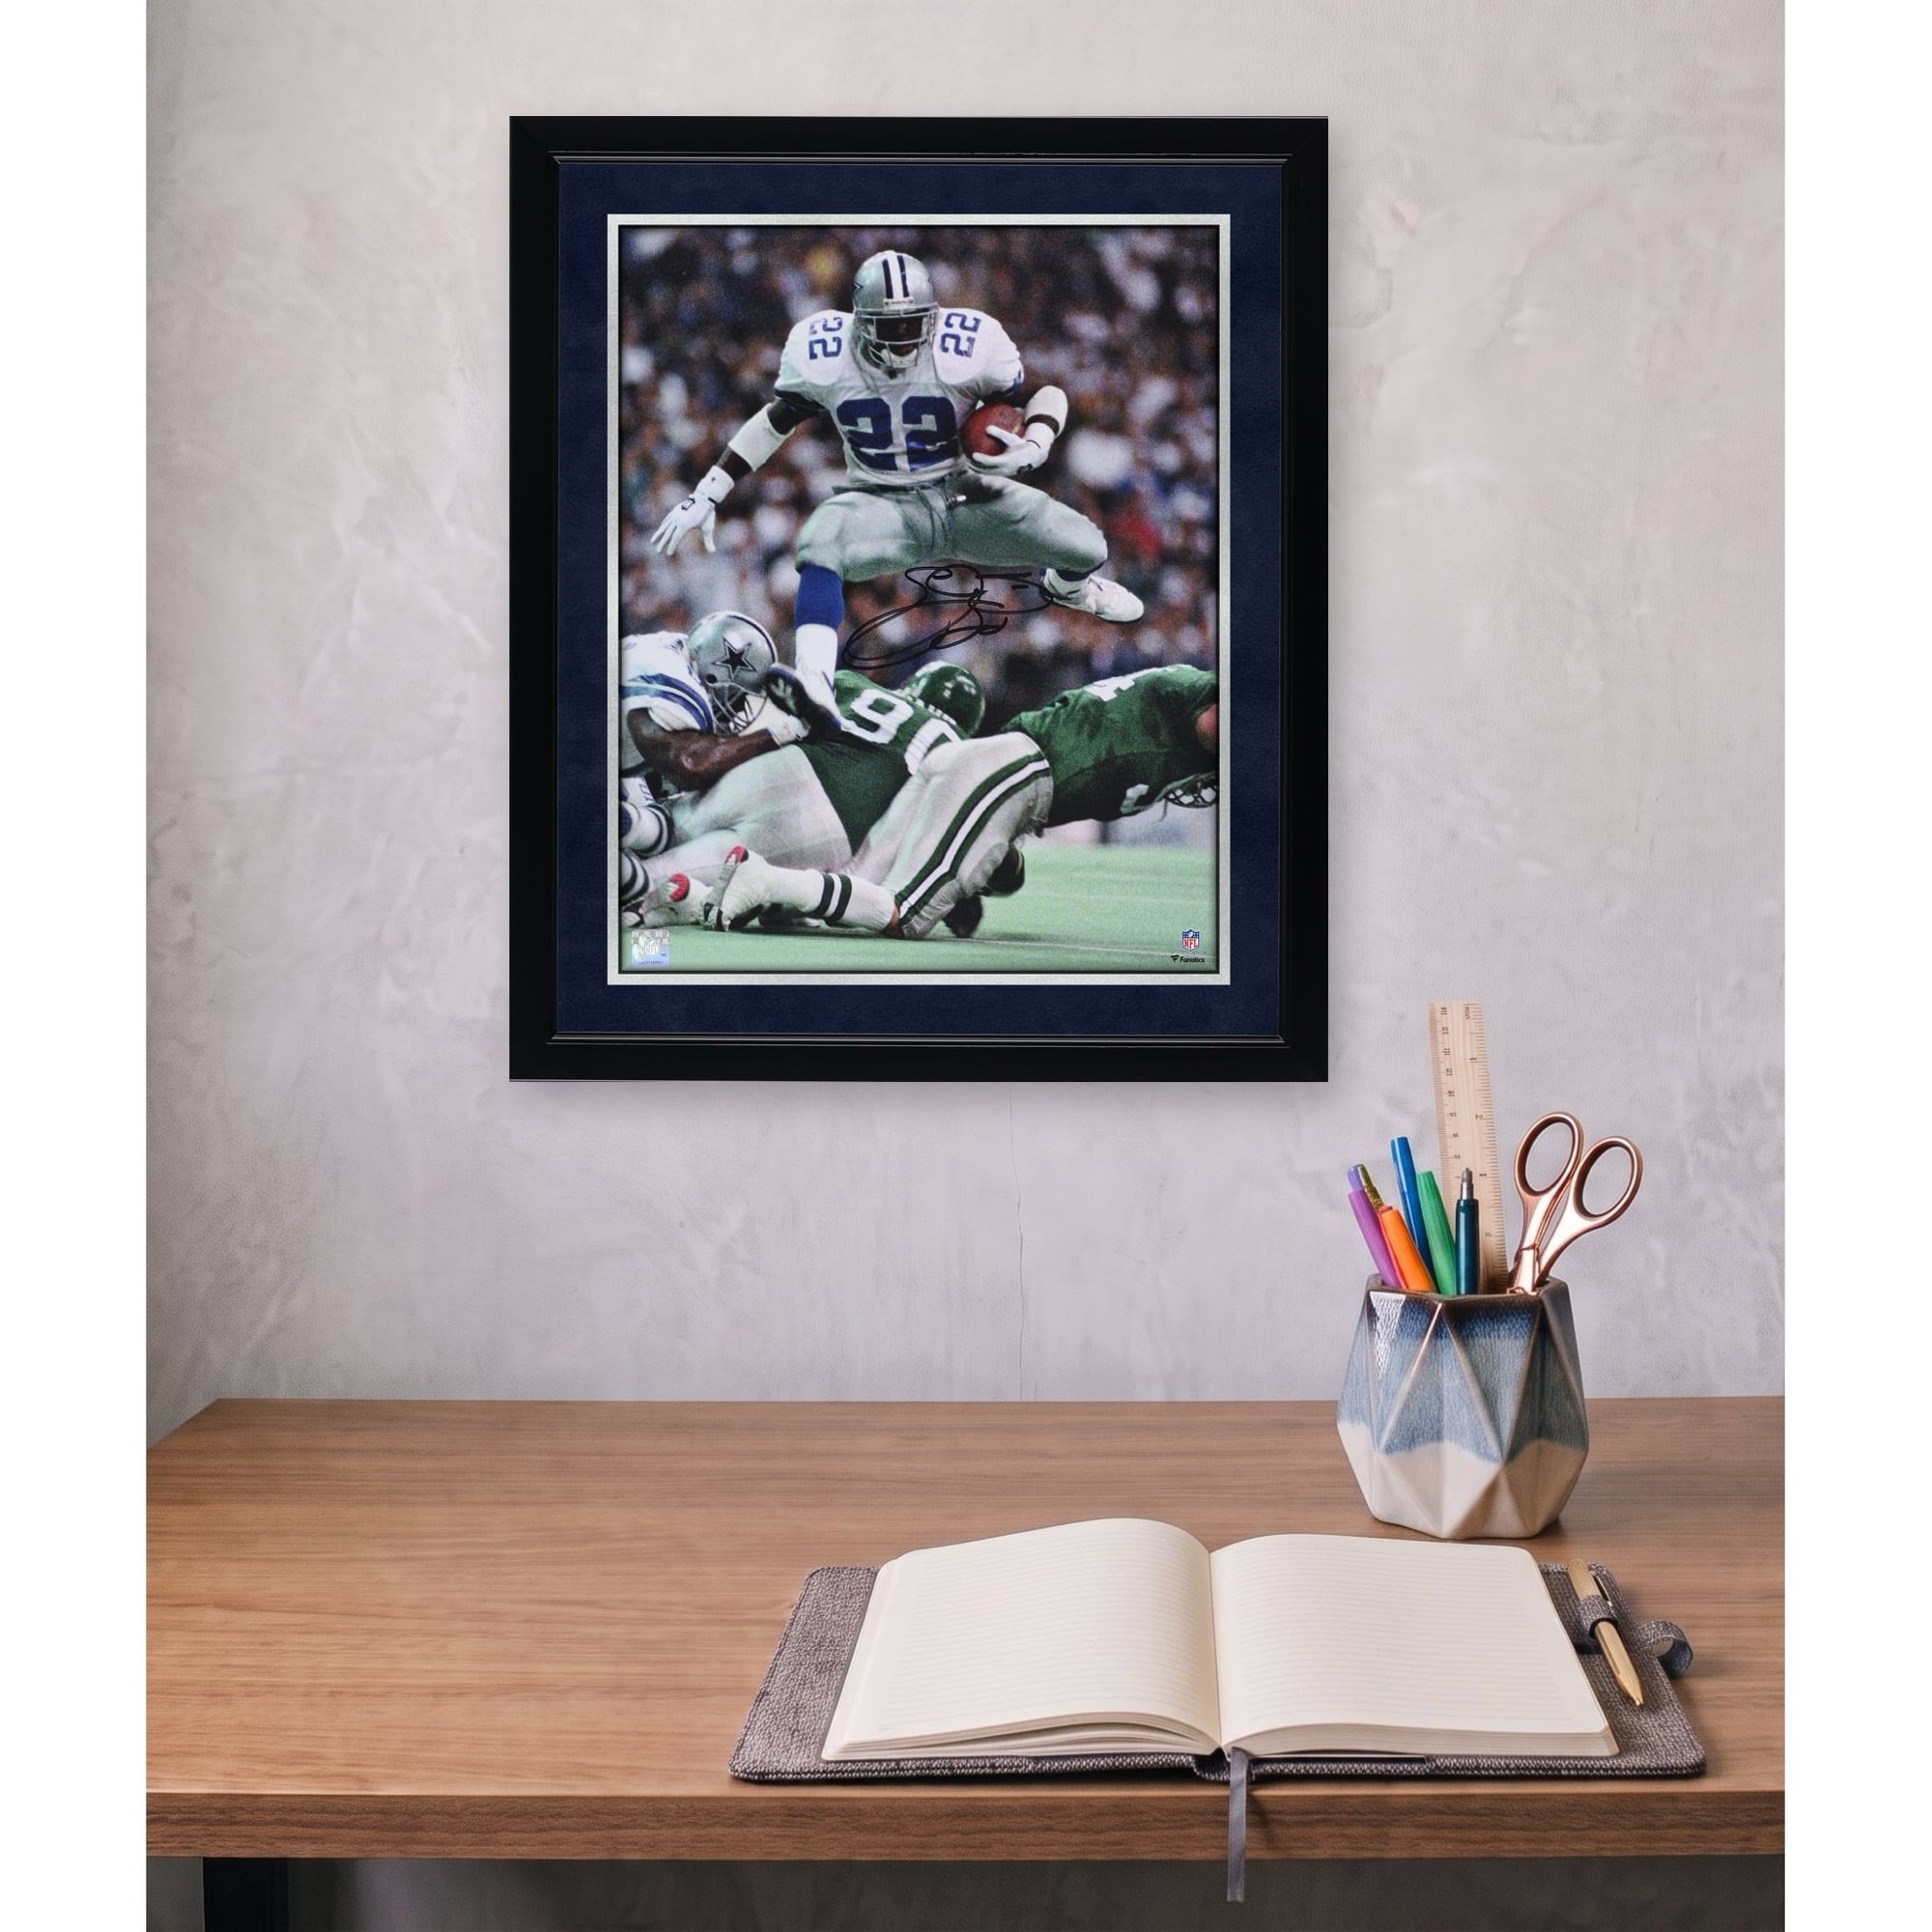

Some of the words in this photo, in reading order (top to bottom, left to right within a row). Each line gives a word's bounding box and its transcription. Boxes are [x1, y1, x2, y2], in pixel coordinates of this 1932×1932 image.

[809, 315, 843, 360] 22
[940, 312, 981, 358] 22
[836, 396, 959, 471] 22
[1183, 938, 1197, 949] NFL
